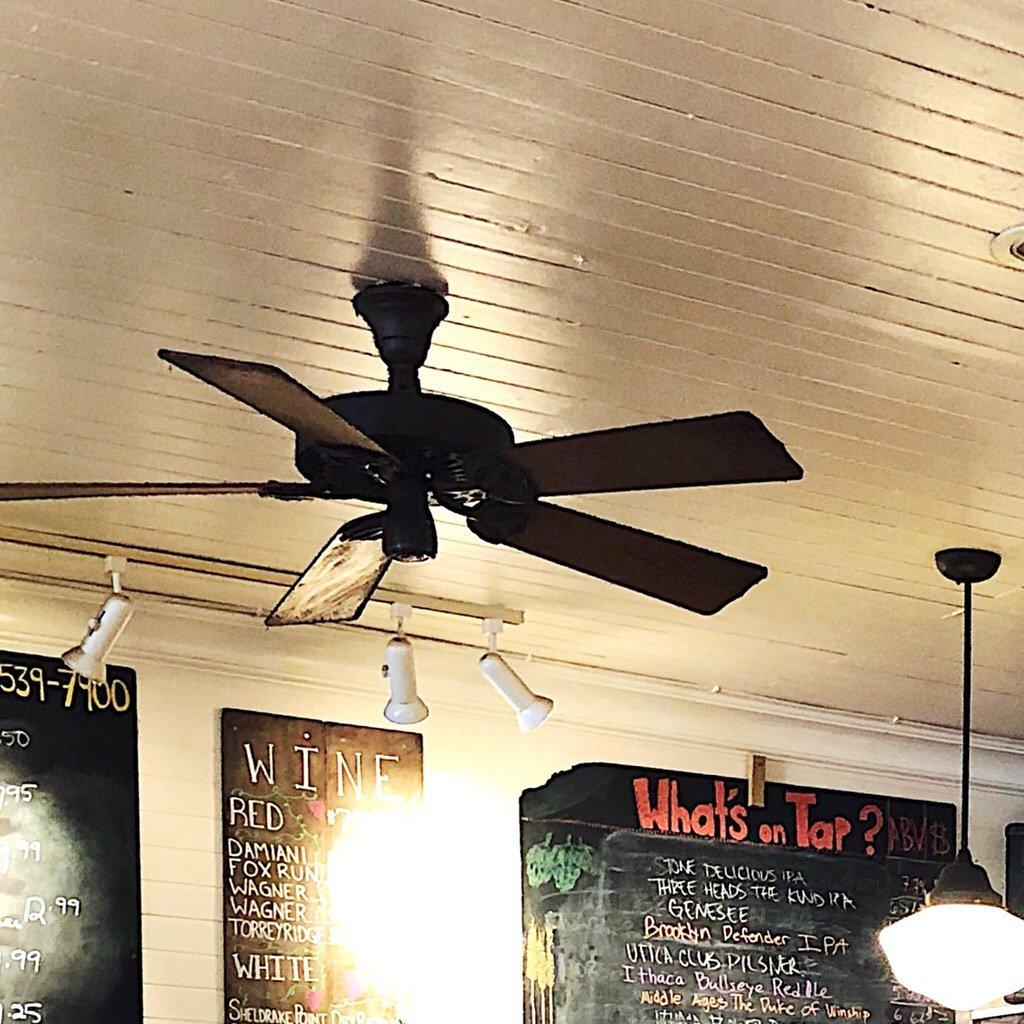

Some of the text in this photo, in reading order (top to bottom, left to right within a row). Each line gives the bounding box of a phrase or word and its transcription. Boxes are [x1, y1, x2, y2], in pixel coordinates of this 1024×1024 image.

[229, 797, 284, 831] RED
[633, 777, 748, 841] What's
[759, 824, 786, 845] on
[786, 792, 851, 853] Tap
[228, 838, 308, 865] DAMIANI
[229, 859, 319, 882] FOX RUN
[703, 862, 777, 882] DELICIOUS
[782, 870, 807, 887] IPA
[229, 879, 308, 900] WAGNER
[647, 877, 696, 897] THREE
[704, 883, 747, 900] HEADS
[828, 892, 856, 909] IPA
[230, 897, 308, 922] WAGNER
[668, 899, 749, 924] GENESEE
[643, 915, 850, 956] Brooklyn Defender IPA
[232, 953, 318, 981] WHITE
[625, 943, 673, 965] UTICA
[678, 949, 721, 970] CLUB
[622, 964, 686, 986] Ithaca
[694, 971, 764, 998] Bullseye
[772, 977, 801, 998] Red
[691, 993, 728, 1013] Ages
[730, 993, 756, 1012] The
[760, 997, 796, 1015] Duke
[801, 1001, 821, 1018] of
